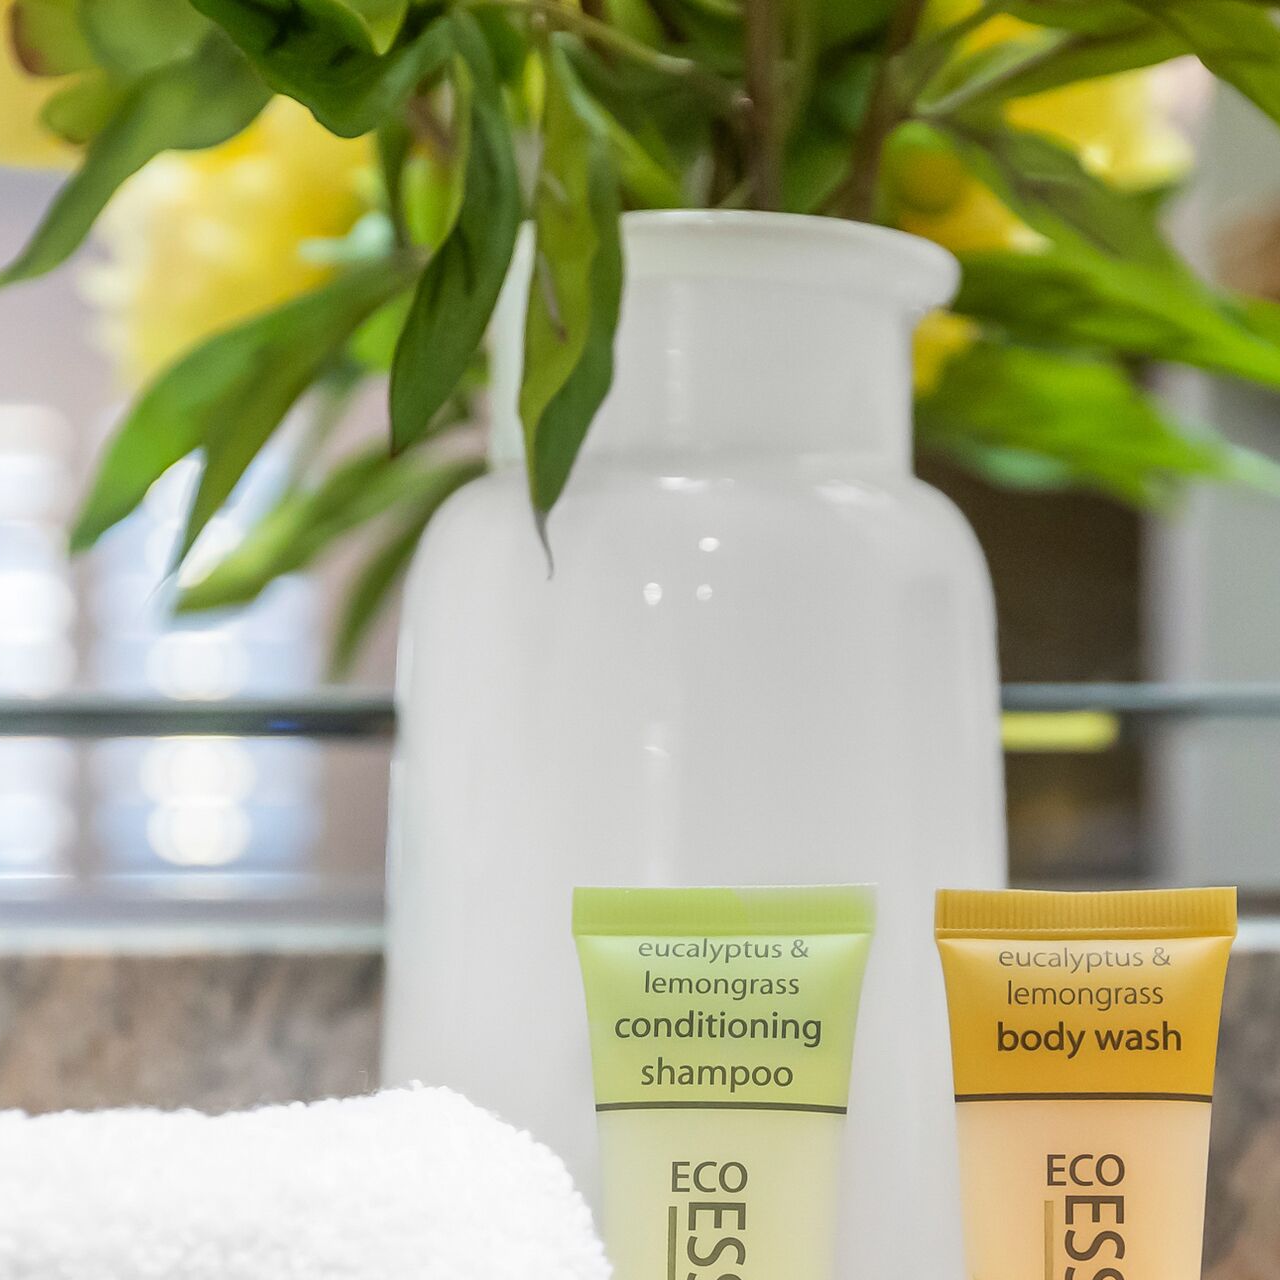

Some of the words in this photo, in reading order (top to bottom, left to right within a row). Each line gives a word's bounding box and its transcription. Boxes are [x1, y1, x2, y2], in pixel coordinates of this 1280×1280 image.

[638, 938, 783, 963] eucalyptus
[790, 939, 809, 959] &
[999, 948, 1144, 974] eucalyptus
[1152, 947, 1171, 966] &
[644, 970, 800, 1000] lemongrass
[1007, 980, 1163, 1011] lemongrass
[615, 1010, 822, 1048] conditioning
[997, 1021, 1085, 1059] body
[1095, 1021, 1182, 1051] wash
[641, 1057, 794, 1093] shampoo
[671, 1161, 748, 1193] ECO
[1047, 1154, 1125, 1187] ECO
